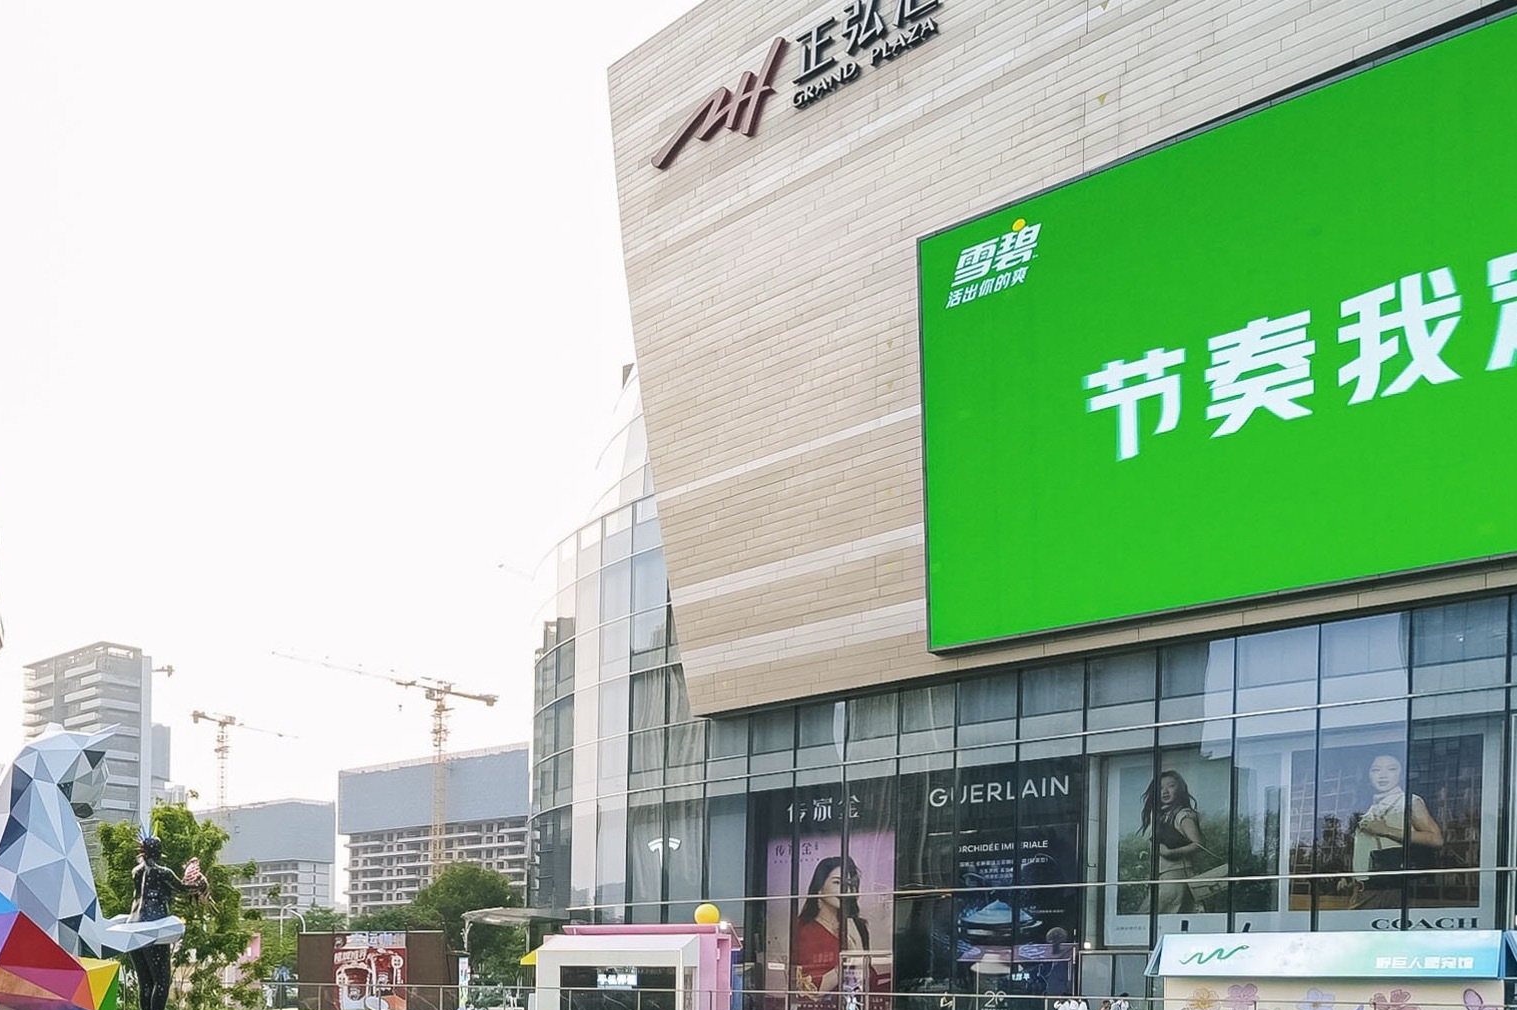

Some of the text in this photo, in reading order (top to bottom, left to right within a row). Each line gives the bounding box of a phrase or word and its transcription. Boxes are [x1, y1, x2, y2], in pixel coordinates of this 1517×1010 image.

[792, 17, 939, 108] GRAND PLAZA
[951, 222, 1042, 287] 雪碧
[946, 266, 1029, 309] 活出你的爽
[929, 775, 1069, 807] GUERLAIN
[959, 843, 999, 853] RCHIDÉE
[1371, 917, 1478, 930] COACH
